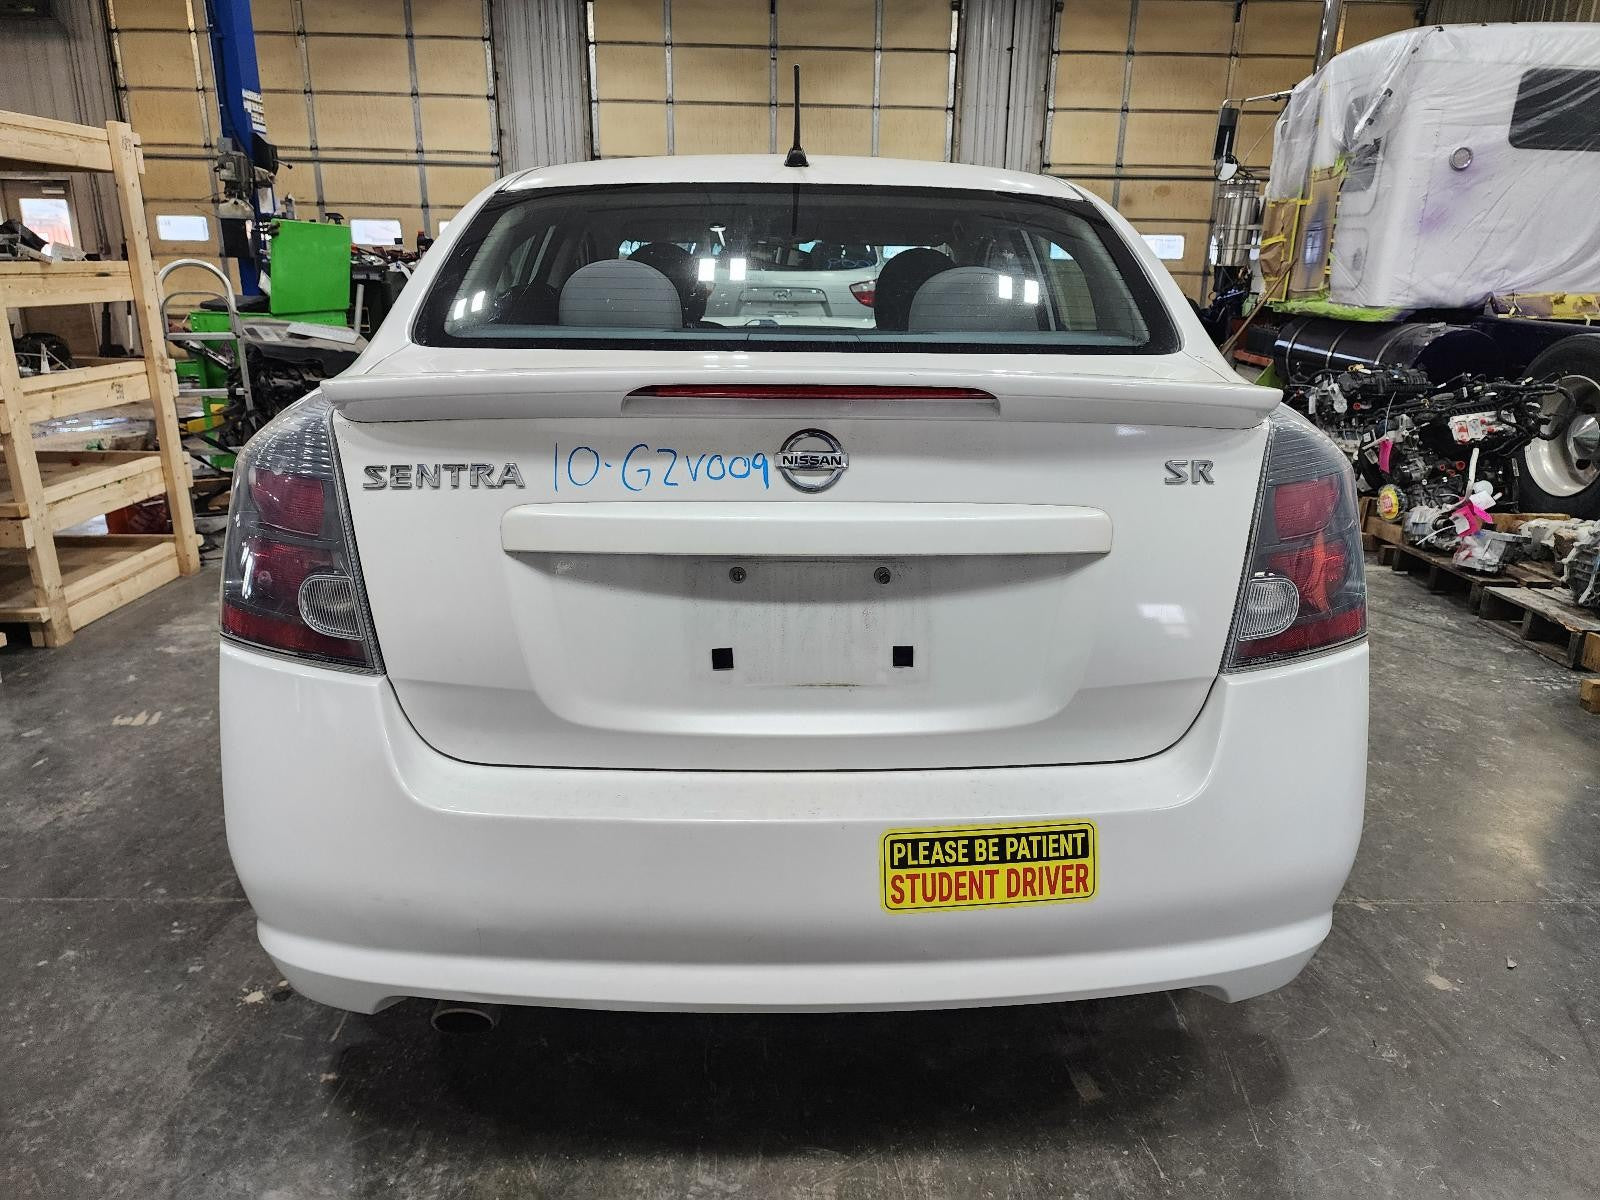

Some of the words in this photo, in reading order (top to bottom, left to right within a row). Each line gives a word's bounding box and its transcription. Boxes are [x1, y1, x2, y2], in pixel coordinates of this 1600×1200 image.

[782, 455, 842, 466] NISSAN
[1164, 459, 1215, 485] SR
[362, 462, 526, 490] SENTRA
[893, 839, 969, 866] PLEASE
[974, 837, 1000, 862] BE
[1005, 832, 1086, 860] PATIENT
[890, 869, 1000, 905] STUDENT
[1006, 863, 1089, 899] DRIVER
